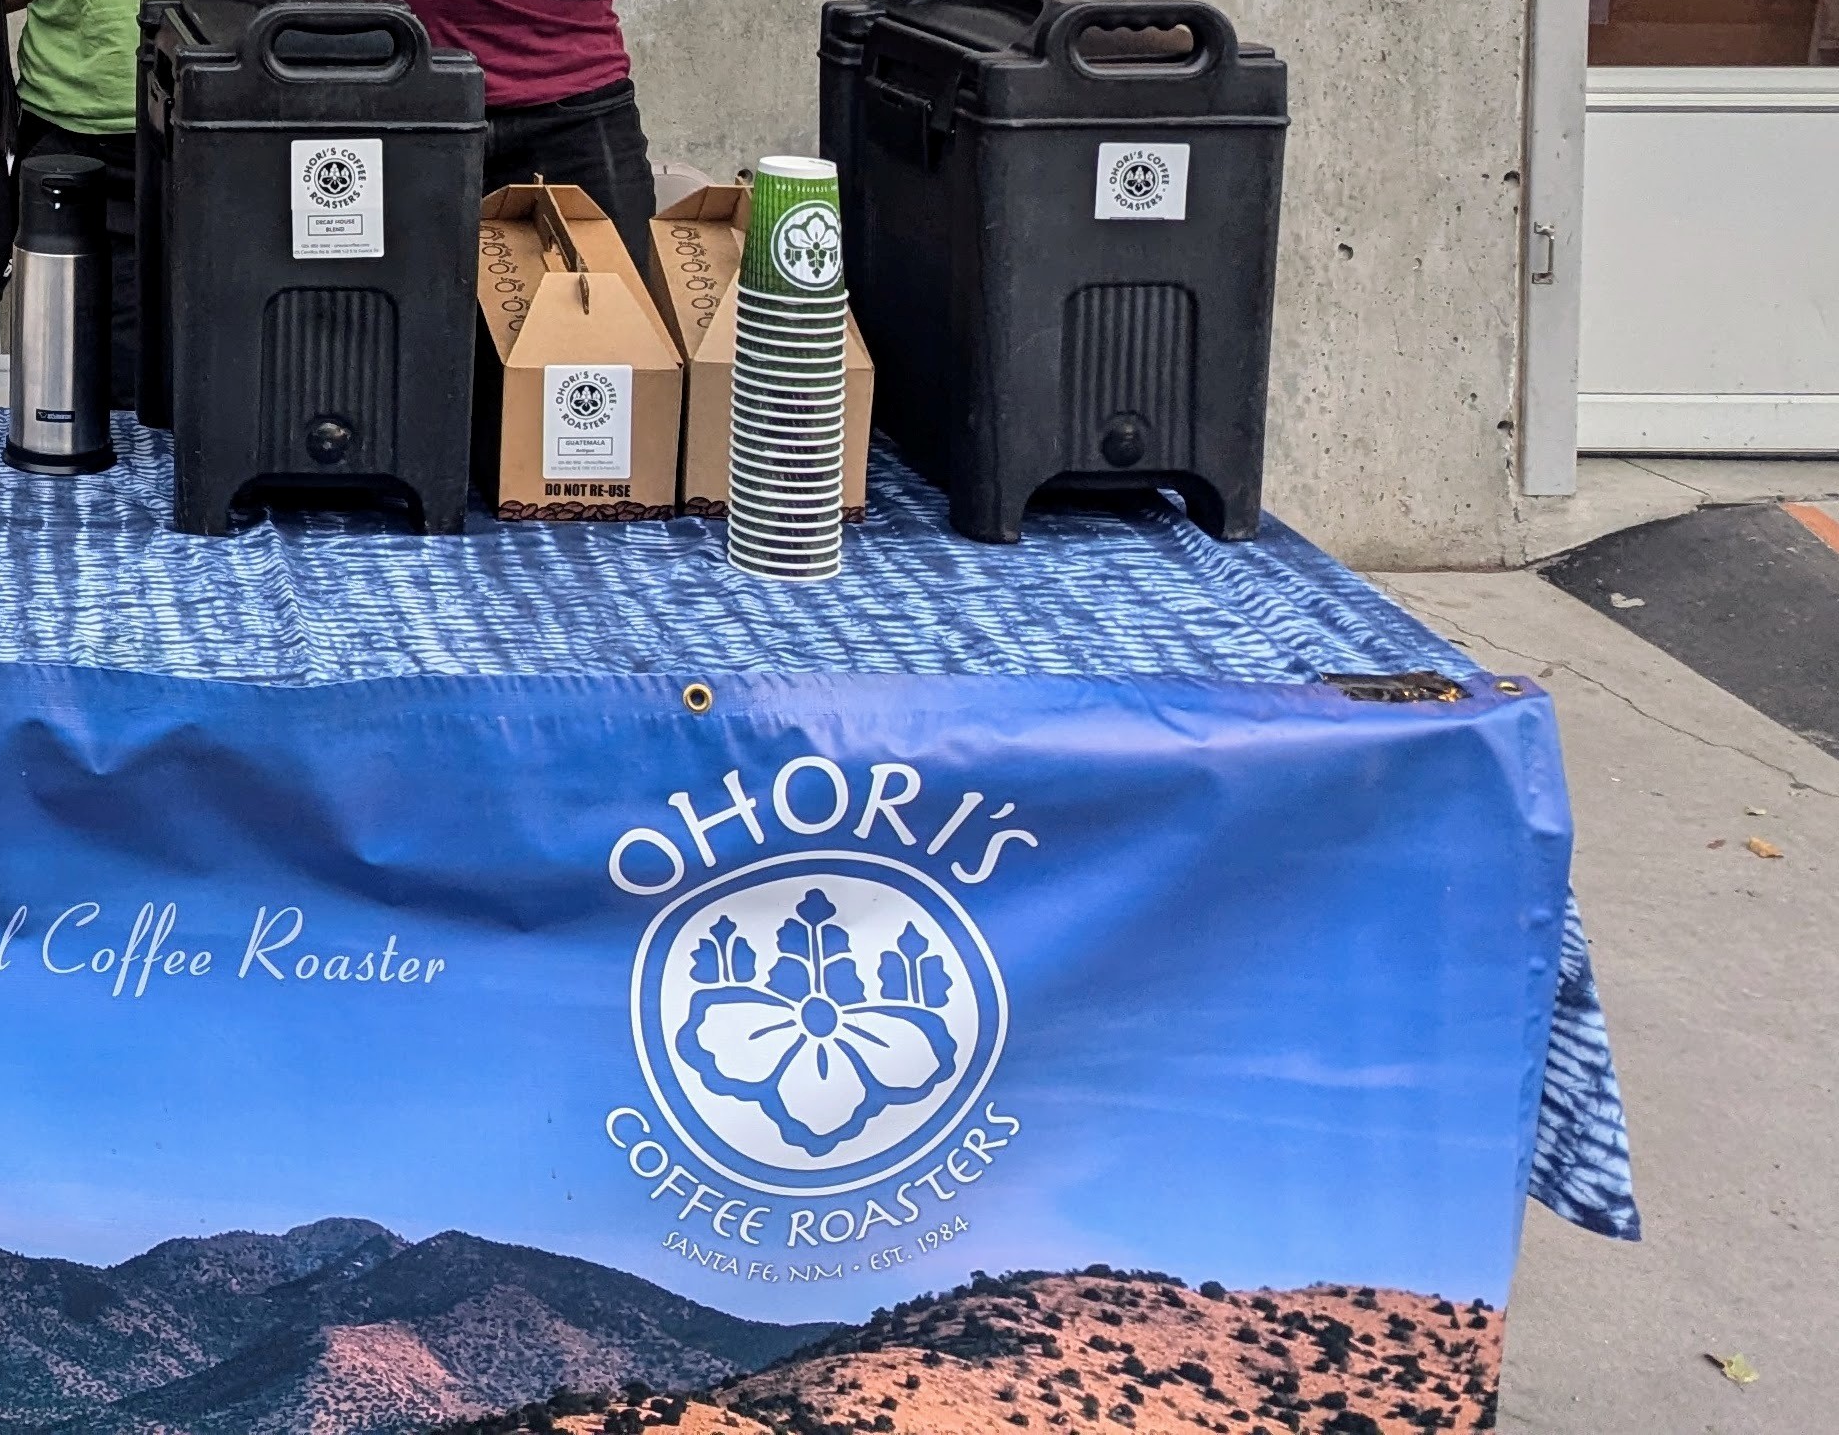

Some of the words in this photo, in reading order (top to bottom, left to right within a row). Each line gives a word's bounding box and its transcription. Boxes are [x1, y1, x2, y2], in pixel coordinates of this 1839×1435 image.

[303, 147, 337, 183] OHORI'S
[341, 149, 367, 181] COFFEE
[1109, 151, 1143, 185] OHORI'S
[1147, 153, 1170, 185] COFFEE
[309, 189, 361, 209] ROASTERS
[1114, 193, 1163, 211] ROASTERS
[556, 371, 589, 405] OHORI'S
[594, 373, 617, 404] COFFEE
[561, 412, 611, 430] ROASTERS
[545, 483, 561, 496] DO
[564, 483, 587, 496] NOT
[589, 484, 631, 498] RE-USE
[608, 756, 1038, 895] OHORI'S
[40, 900, 212, 999] Coffee
[238, 906, 447, 984] Roaster
[606, 1107, 770, 1245] COFFEE
[788, 1101, 1020, 1247] ROASTERS
[662, 1231, 739, 1276] SANTA
[748, 1261, 779, 1284] FE,
[789, 1264, 843, 1280] NM
[870, 1245, 913, 1272] EST.
[918, 1216, 970, 1254] 1984
